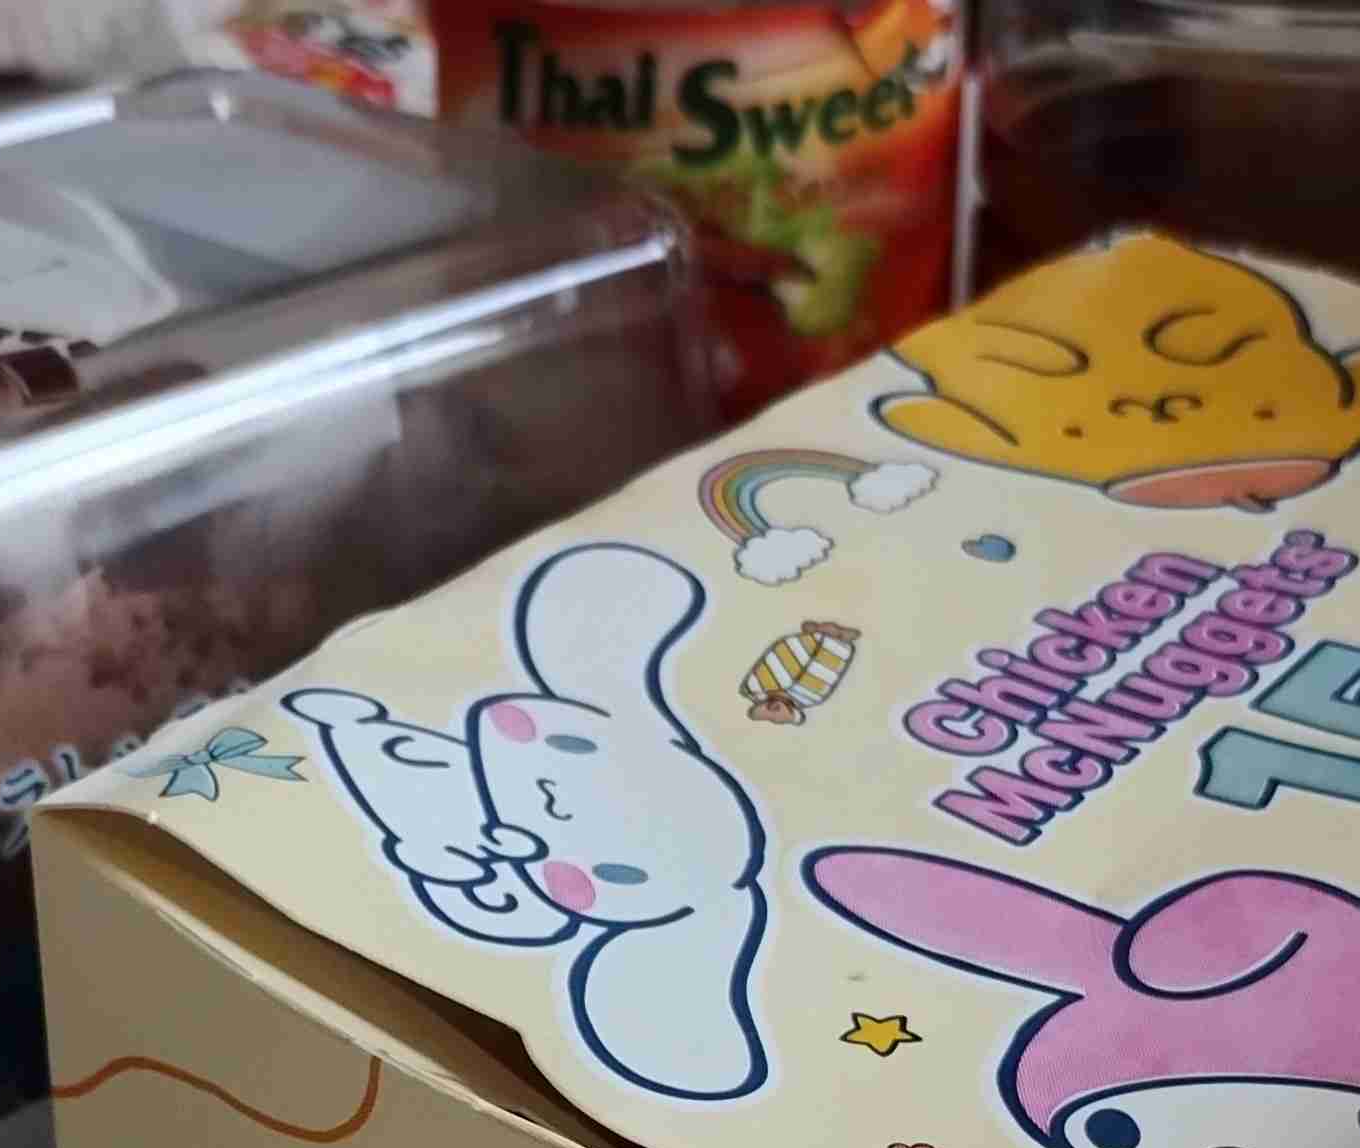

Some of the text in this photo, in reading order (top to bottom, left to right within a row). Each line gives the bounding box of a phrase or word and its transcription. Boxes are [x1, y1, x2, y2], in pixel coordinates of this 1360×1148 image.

[493, 17, 658, 130] Thai
[671, 40, 922, 168] Sweet
[902, 551, 1228, 758] Chicken
